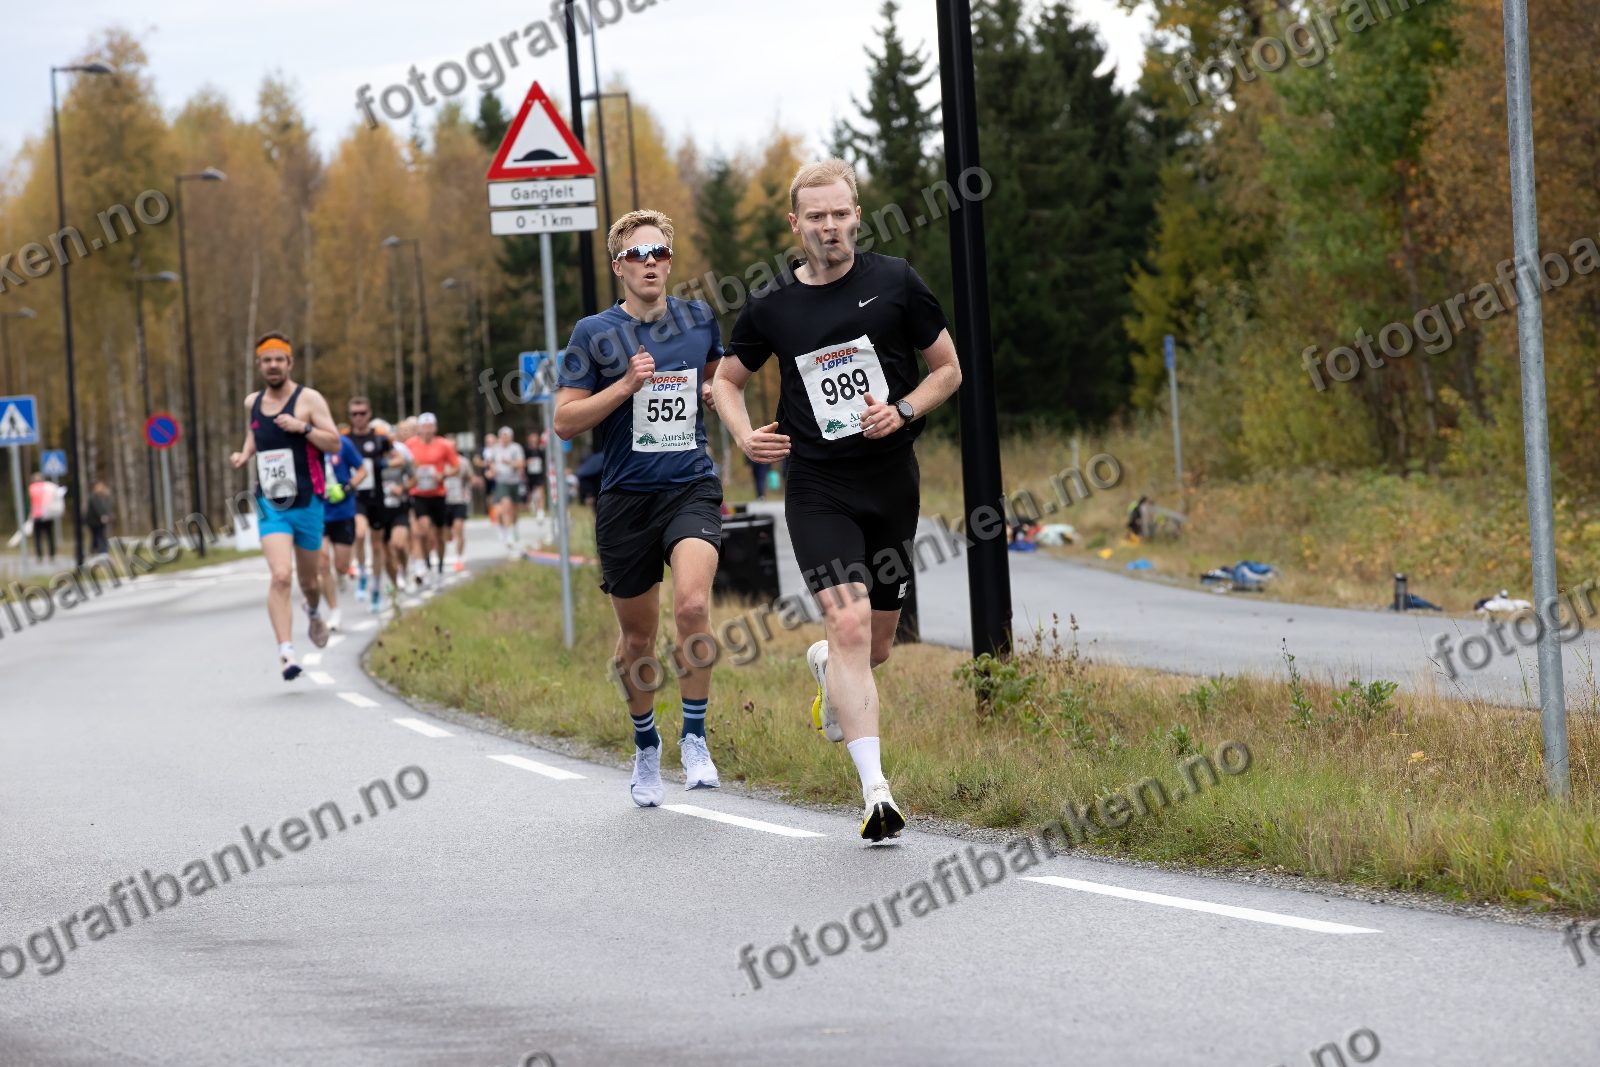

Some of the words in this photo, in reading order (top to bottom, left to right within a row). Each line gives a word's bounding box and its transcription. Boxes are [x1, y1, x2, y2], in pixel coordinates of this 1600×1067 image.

[511, 185, 574, 201] Gangfelt
[815, 347, 859, 365] NORGES
[821, 354, 854, 371] LØPET
[650, 376, 689, 384] NORGES
[652, 383, 682, 392] LØPET
[821, 368, 870, 406] 989
[646, 397, 687, 423] 552
[661, 432, 694, 442] Aurskog
[263, 465, 286, 480] 746
